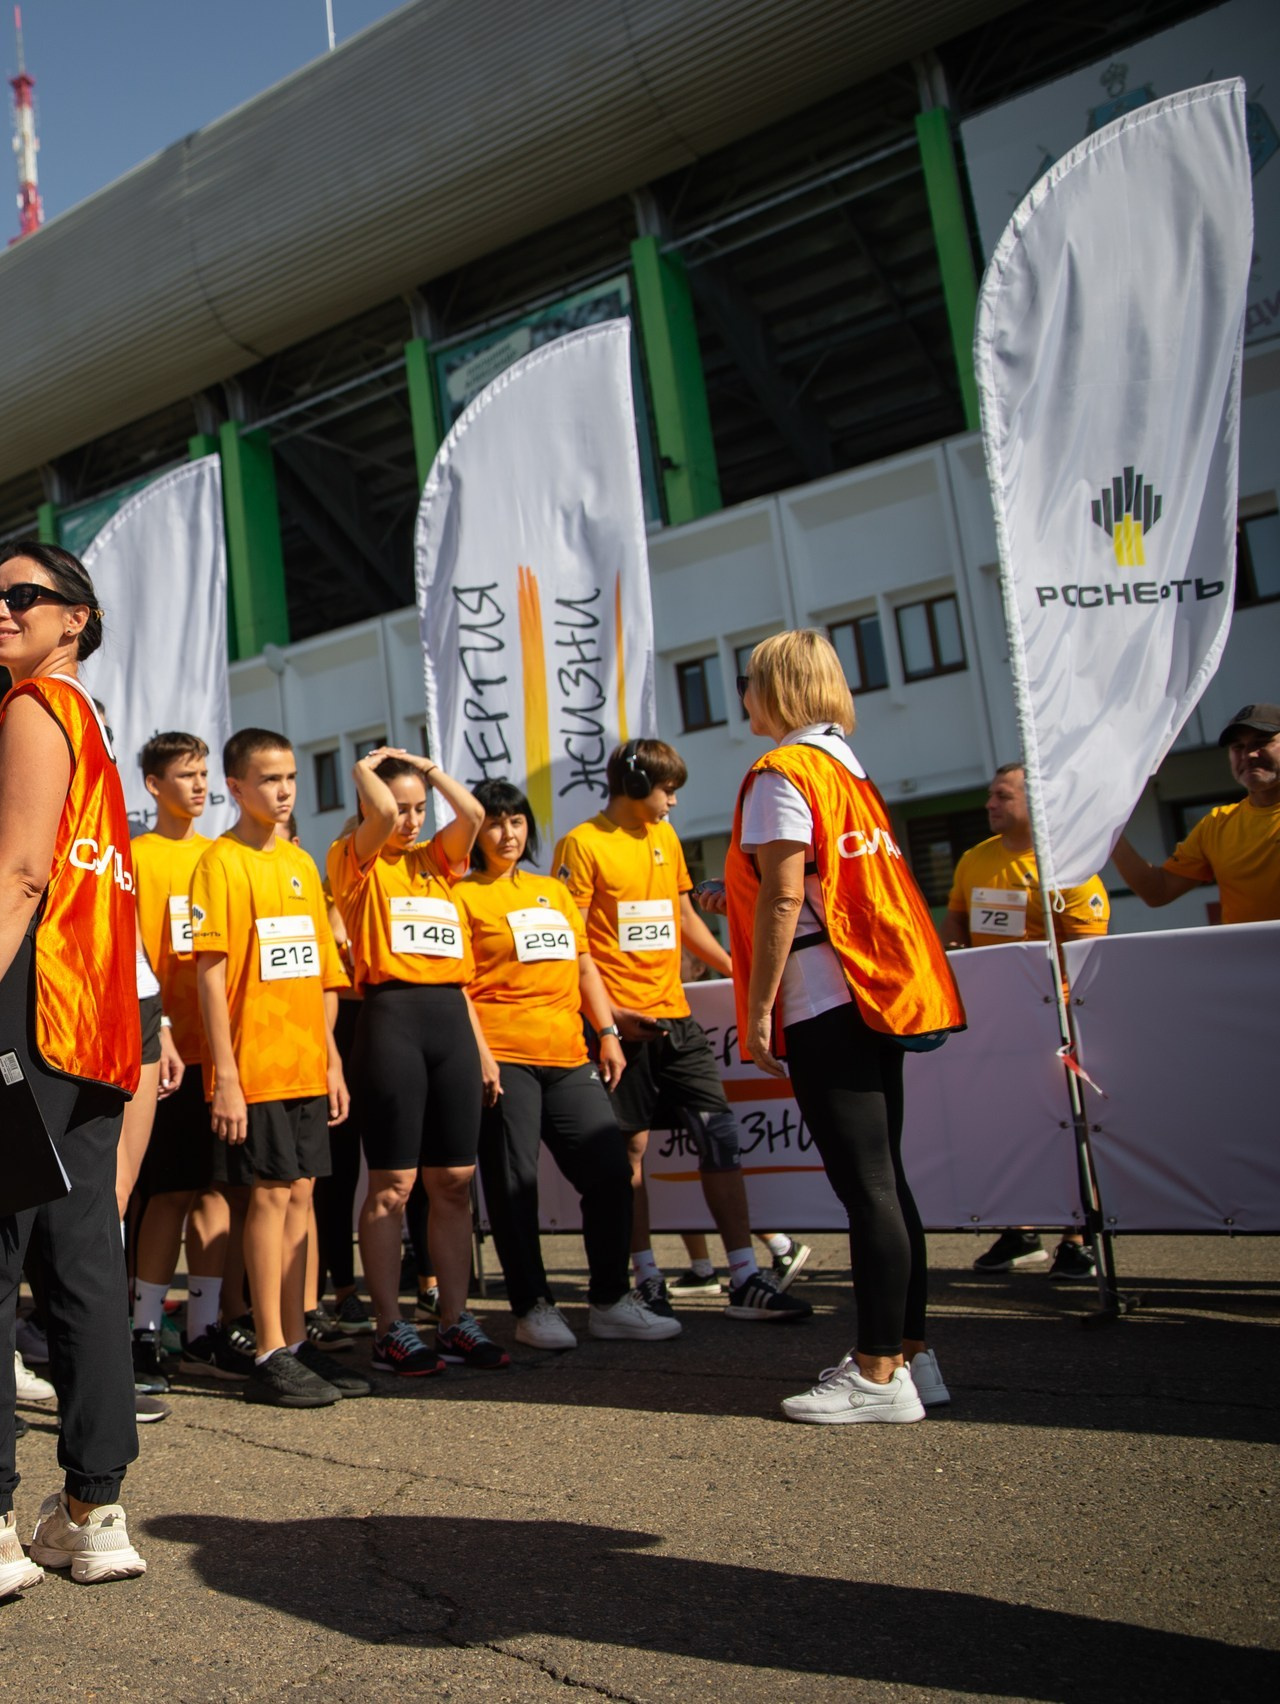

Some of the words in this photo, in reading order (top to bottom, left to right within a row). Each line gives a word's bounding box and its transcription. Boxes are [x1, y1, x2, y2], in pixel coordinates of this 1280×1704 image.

[554, 588, 609, 799] ЖИЗНИ
[980, 910, 1009, 926] 72
[403, 923, 456, 945] 148
[524, 932, 570, 950] 294
[627, 924, 671, 941] 234
[270, 945, 314, 967] 212
